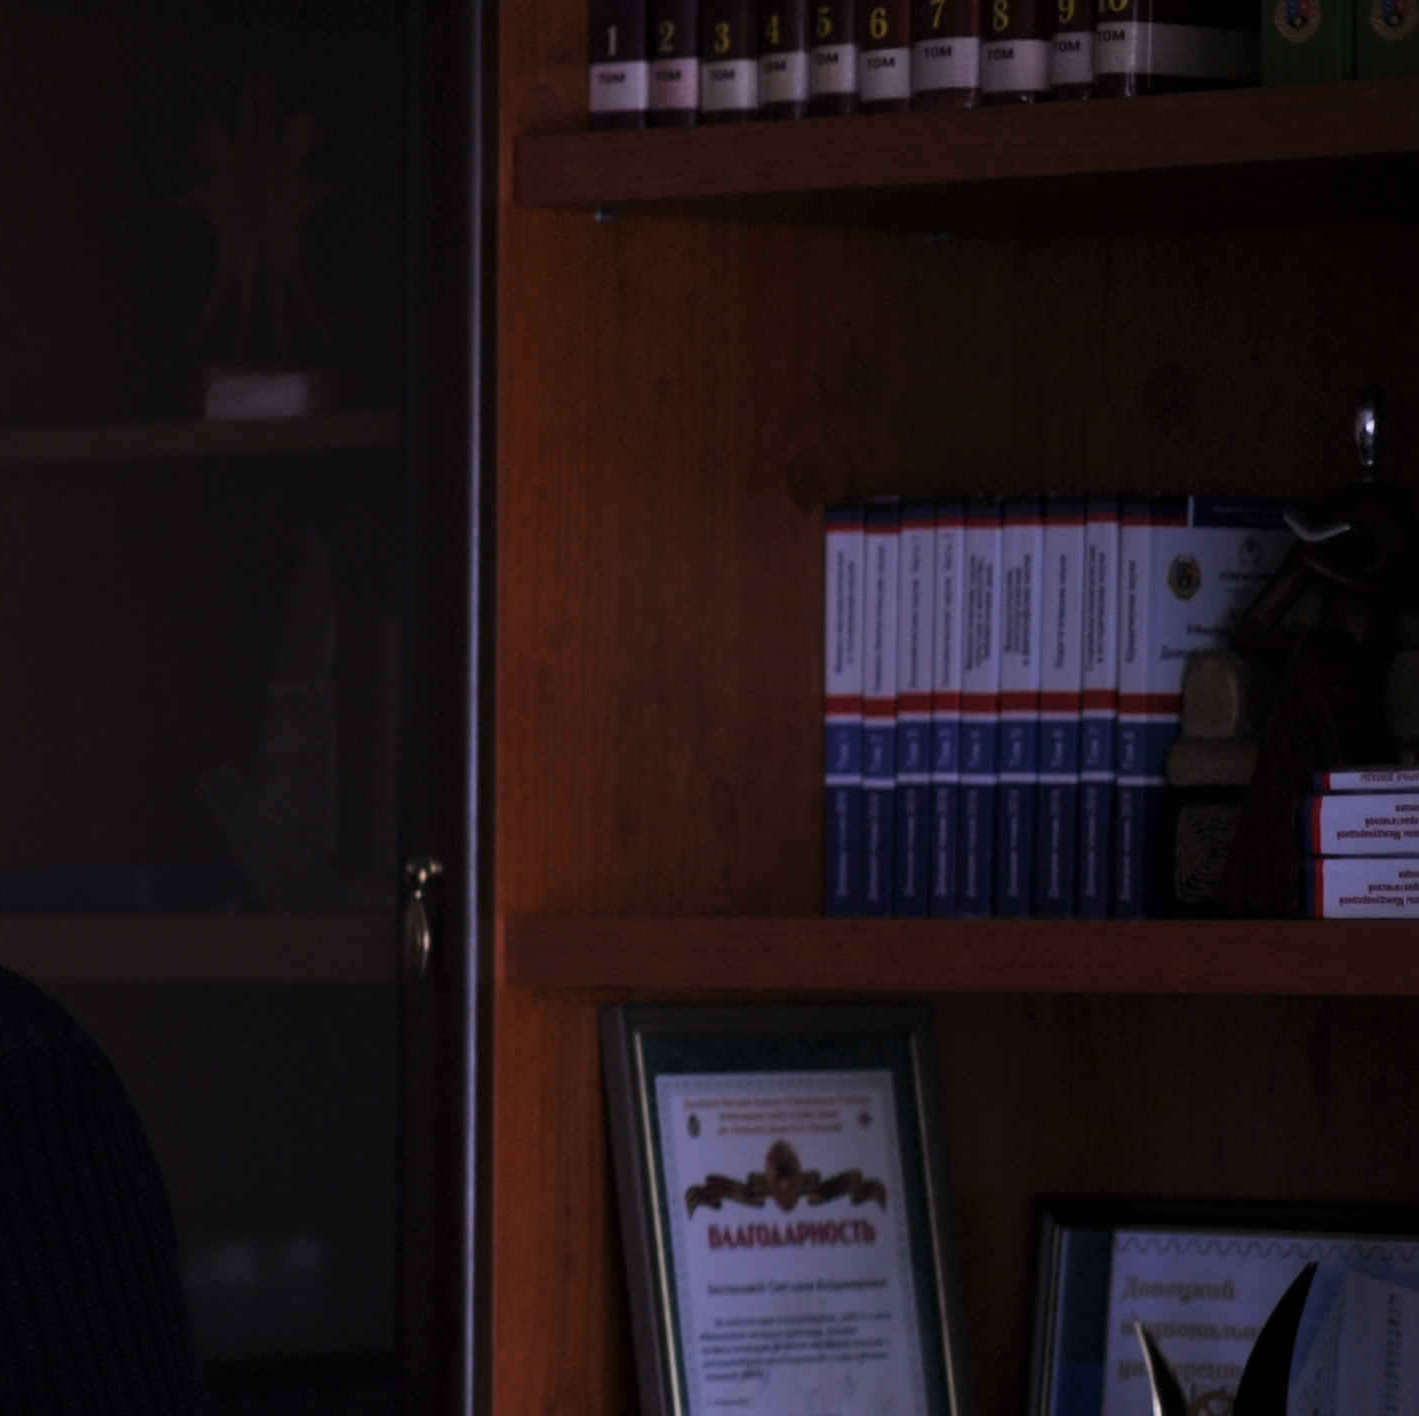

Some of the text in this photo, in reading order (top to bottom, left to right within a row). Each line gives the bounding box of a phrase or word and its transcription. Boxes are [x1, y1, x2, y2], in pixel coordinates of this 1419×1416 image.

[816, 5, 833, 39] 5
[869, 6, 889, 39] 6
[930, 0, 946, 29] 7
[992, 0, 1010, 32] 8
[1057, 0, 1075, 24] 9
[606, 23, 619, 57] 1
[658, 18, 676, 53] 2
[714, 20, 731, 55] 3
[708, 1217, 876, 1249] БЛАГОДАРНОСТЬ
